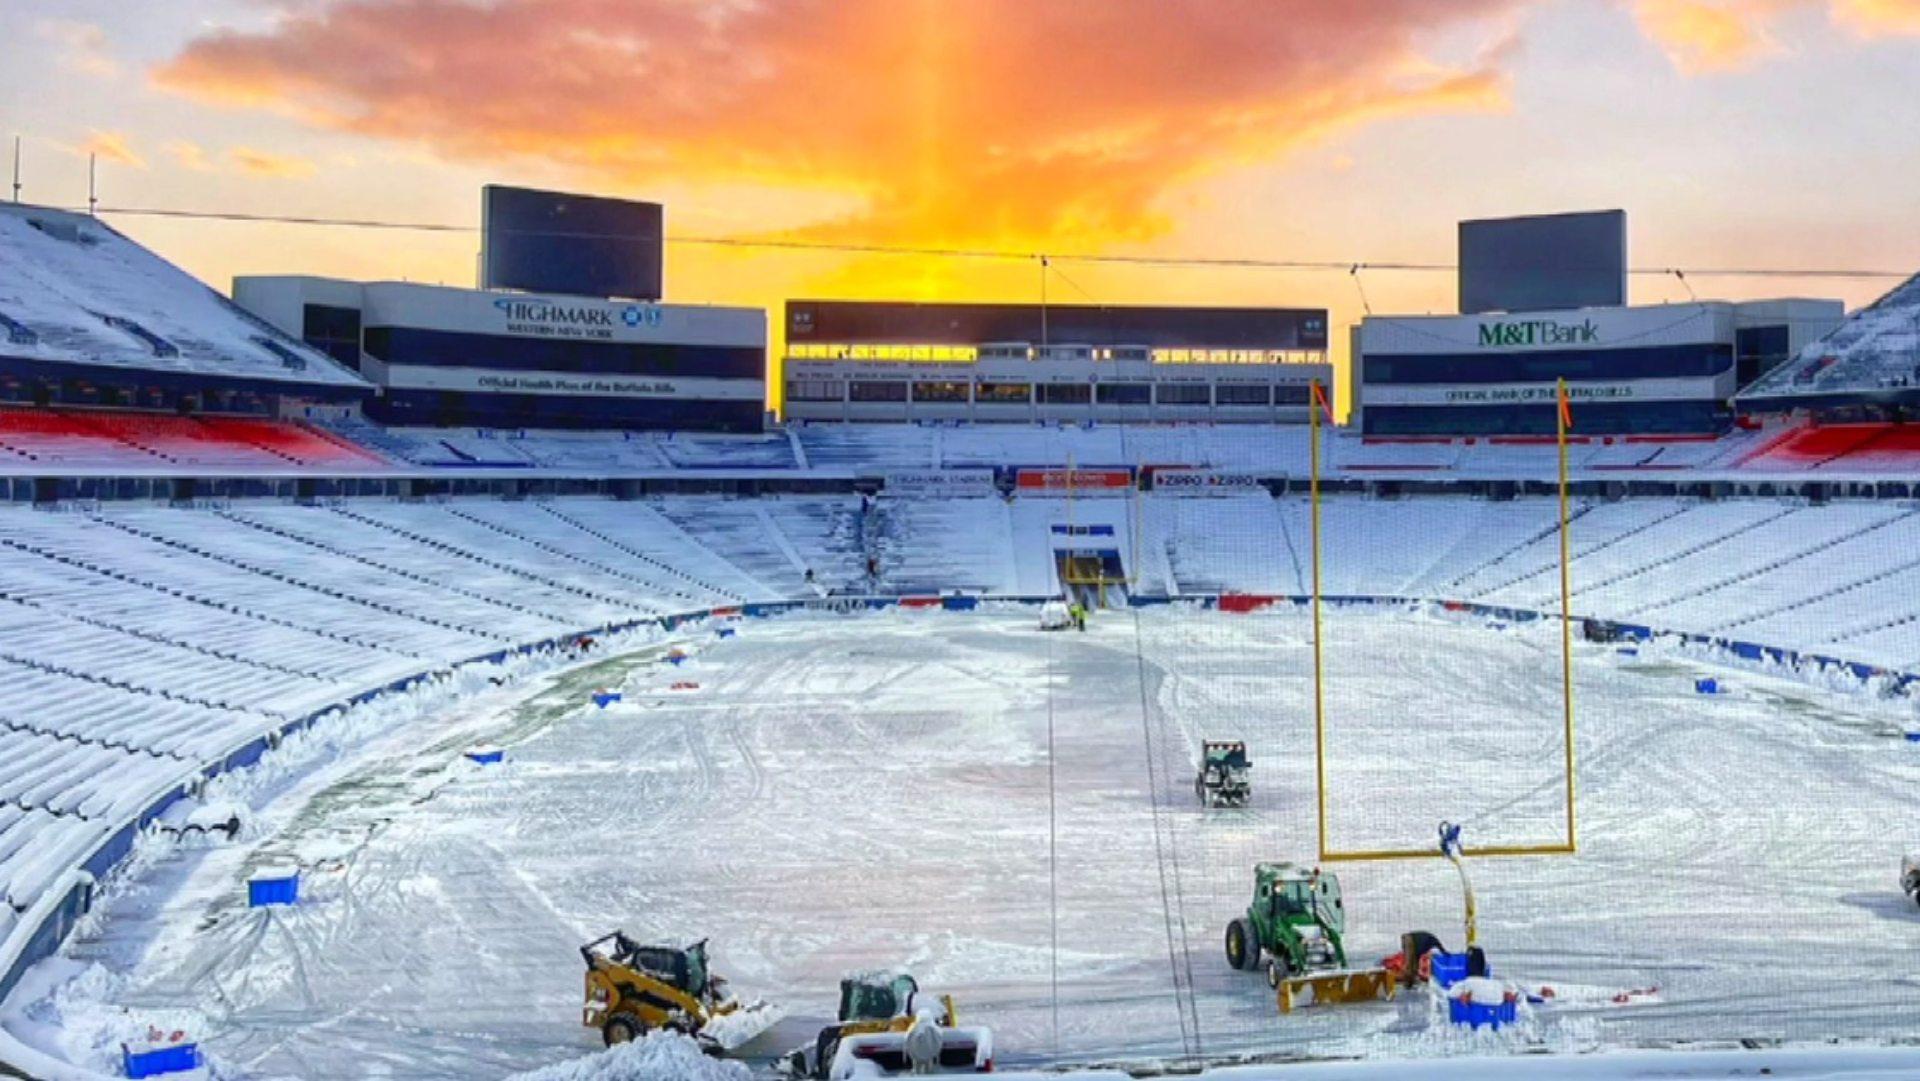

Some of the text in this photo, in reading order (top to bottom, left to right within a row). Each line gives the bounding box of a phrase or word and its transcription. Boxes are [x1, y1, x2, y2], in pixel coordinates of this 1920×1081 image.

[505, 302, 613, 326] HIGHMARK
[507, 323, 614, 338] WESTERN NEW YORK
[1478, 317, 1599, 346] M&T Bank
[478, 375, 676, 394] Official Health Plan of the Buffalo Bills
[1445, 389, 1487, 399] OFFICIAL
[1491, 389, 1519, 399] BANK
[1521, 388, 1535, 398] OF
[1164, 475, 1202, 486] ZIPPO
[1216, 475, 1254, 486] ZIPPO
